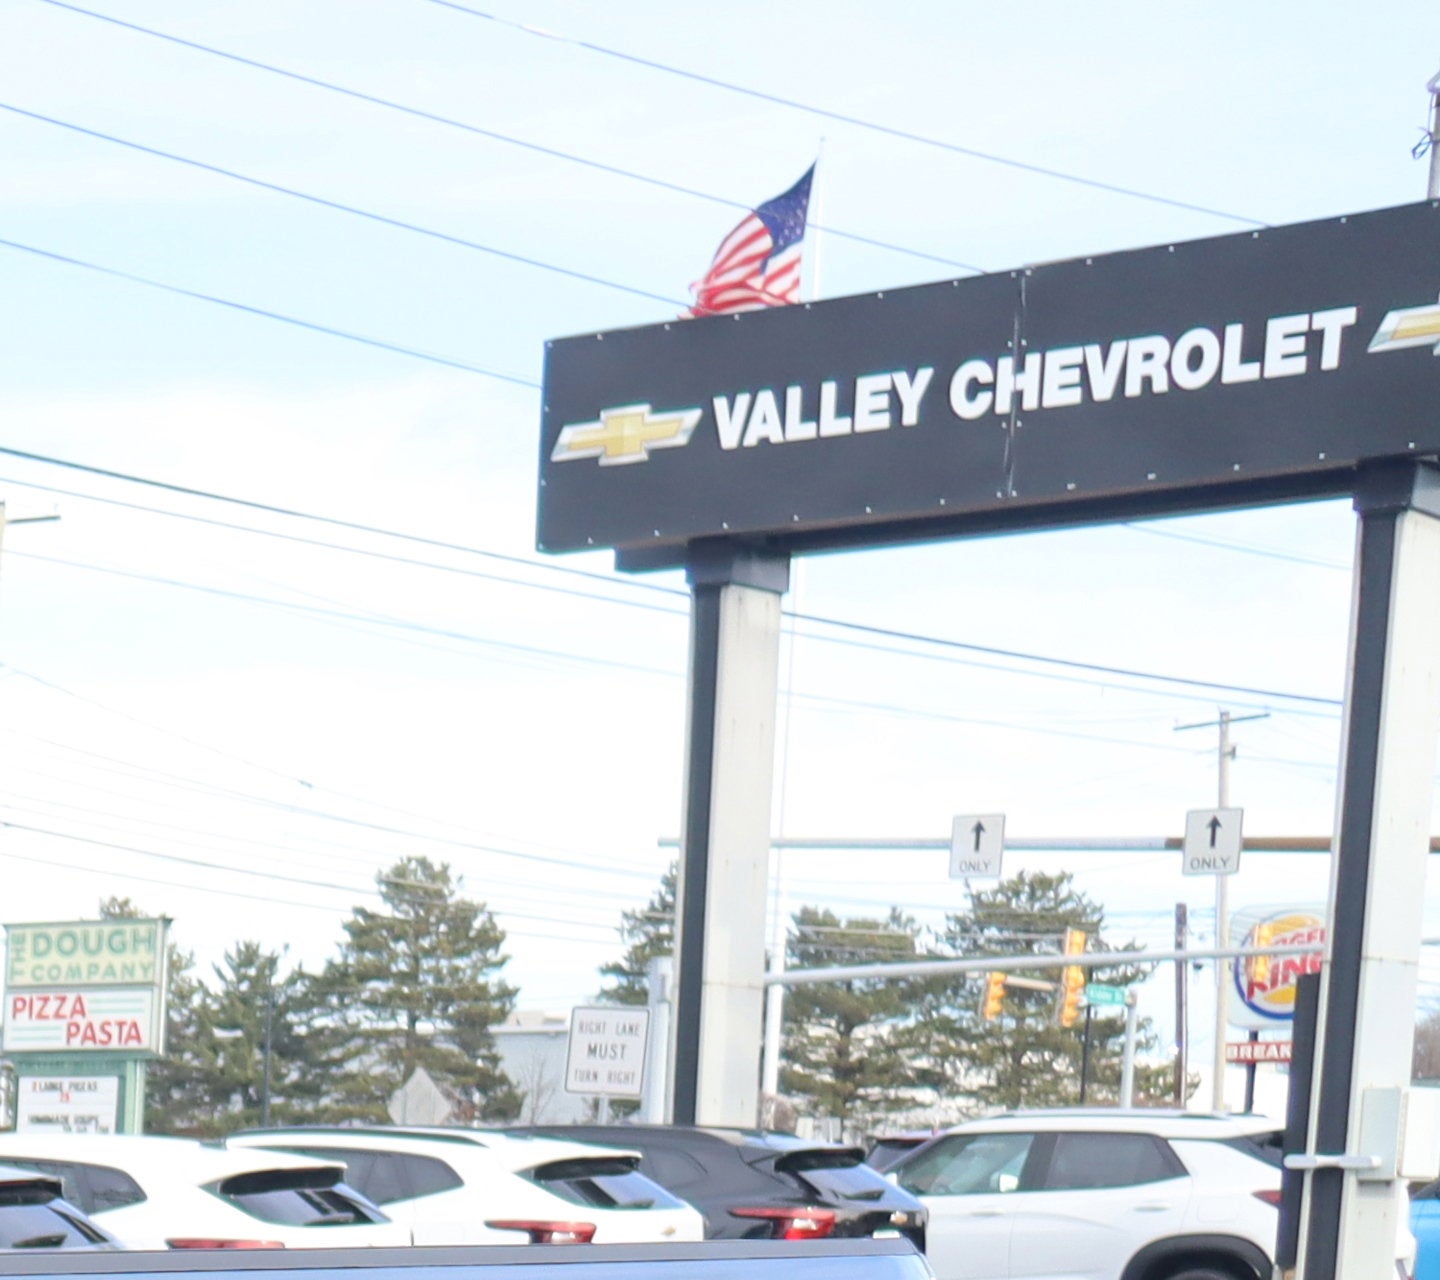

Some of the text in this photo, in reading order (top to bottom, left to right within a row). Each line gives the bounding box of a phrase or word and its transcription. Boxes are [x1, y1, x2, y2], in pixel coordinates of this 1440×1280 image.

[713, 306, 1357, 450] VALLEY CHEVROLET
[958, 855, 993, 874] ONLY
[1189, 854, 1231, 874] ONLY
[32, 928, 154, 956] DOUGH
[9, 932, 27, 981] THE
[32, 963, 153, 982] COMPANY
[11, 994, 87, 1021] PIZZA
[66, 1019, 142, 1046] PASTA
[577, 1020, 640, 1036] RIGHT LANE
[586, 1042, 627, 1060] MUST
[574, 1068, 636, 1085] TURN RIGHT
